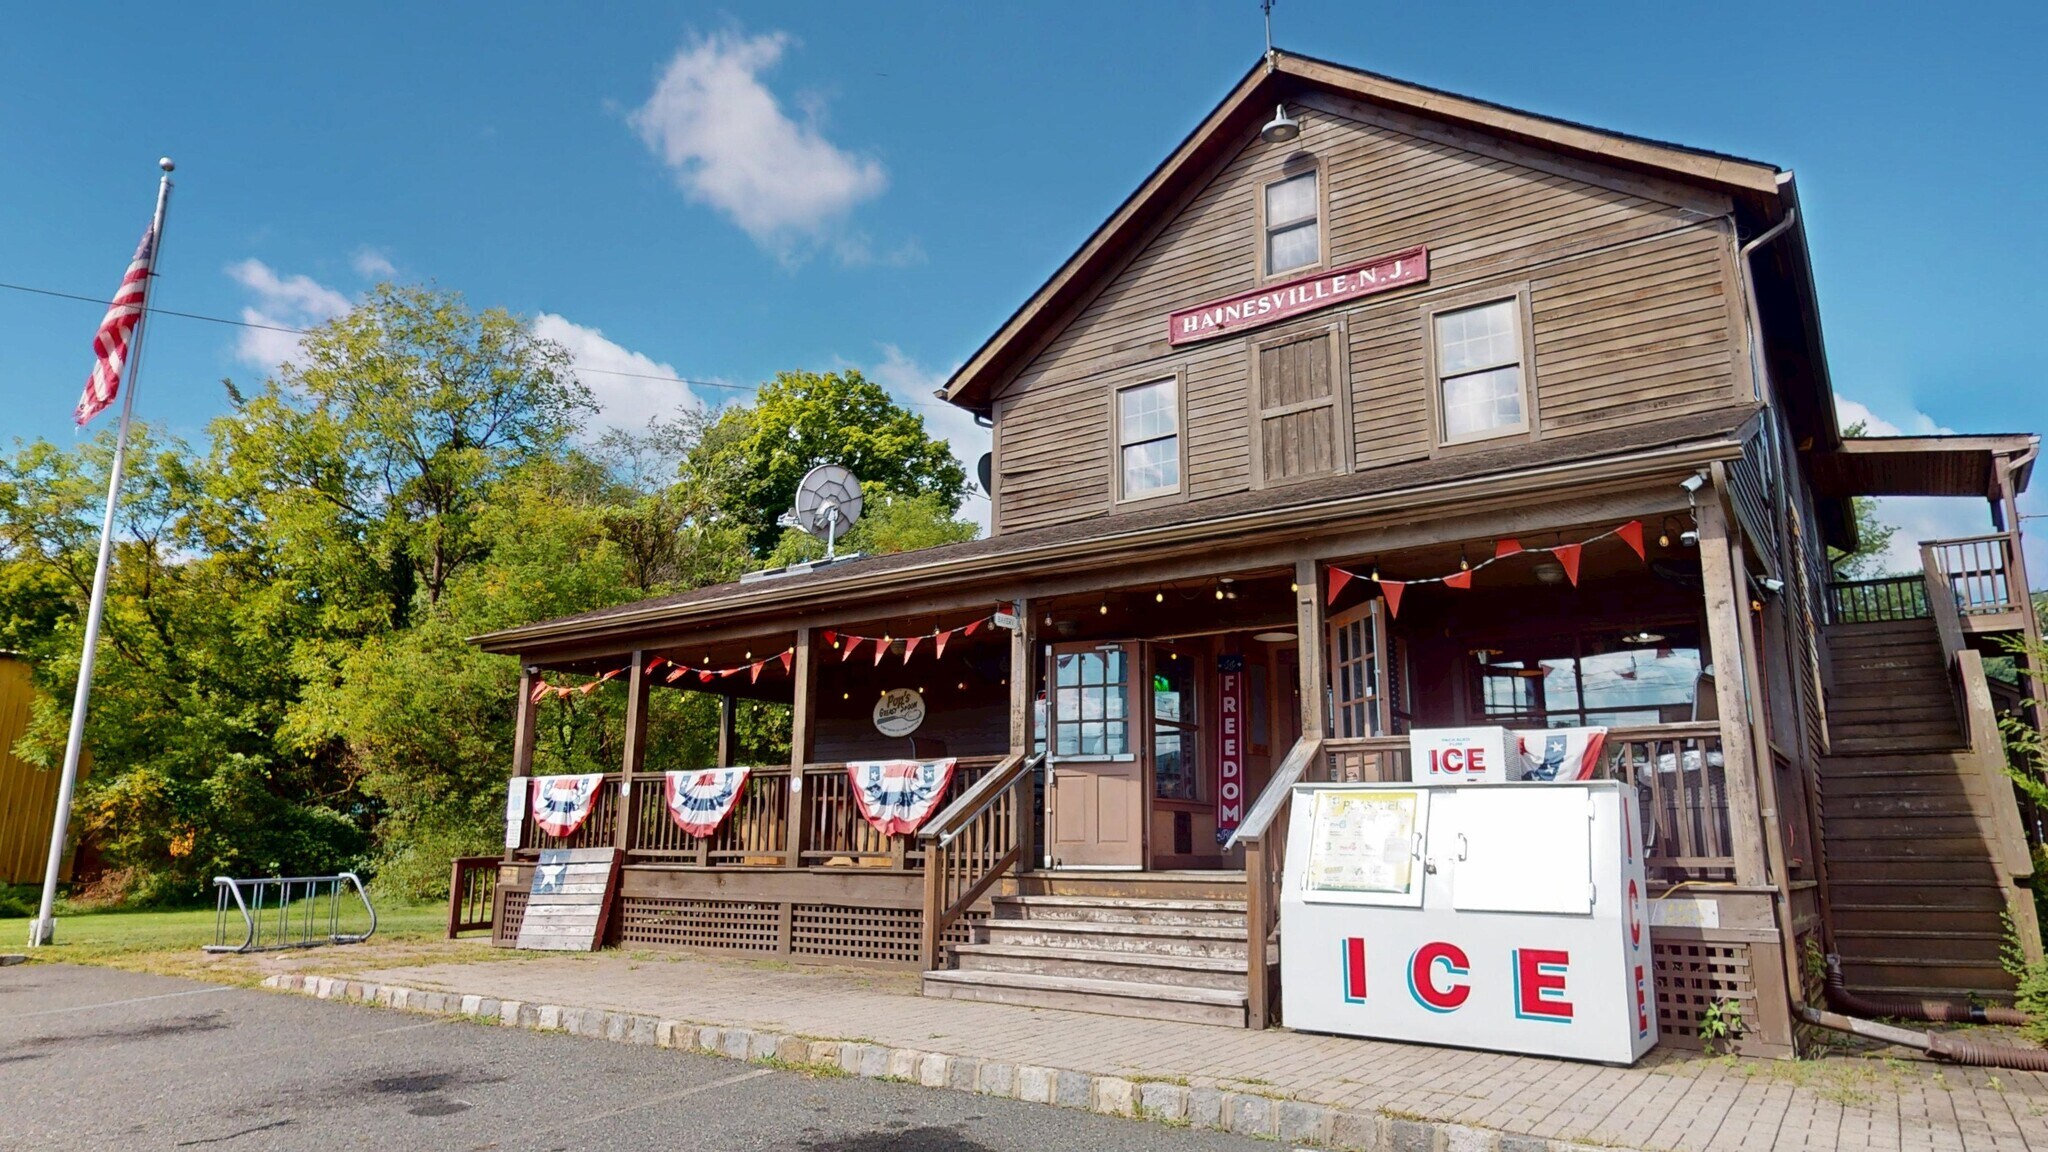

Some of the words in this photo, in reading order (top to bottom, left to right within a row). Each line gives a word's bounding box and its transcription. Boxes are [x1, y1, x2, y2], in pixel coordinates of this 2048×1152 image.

[1221, 675, 1239, 822] FREEDOM
[1428, 748, 1486, 774] ICE
[1342, 937, 1574, 1024] ICE
